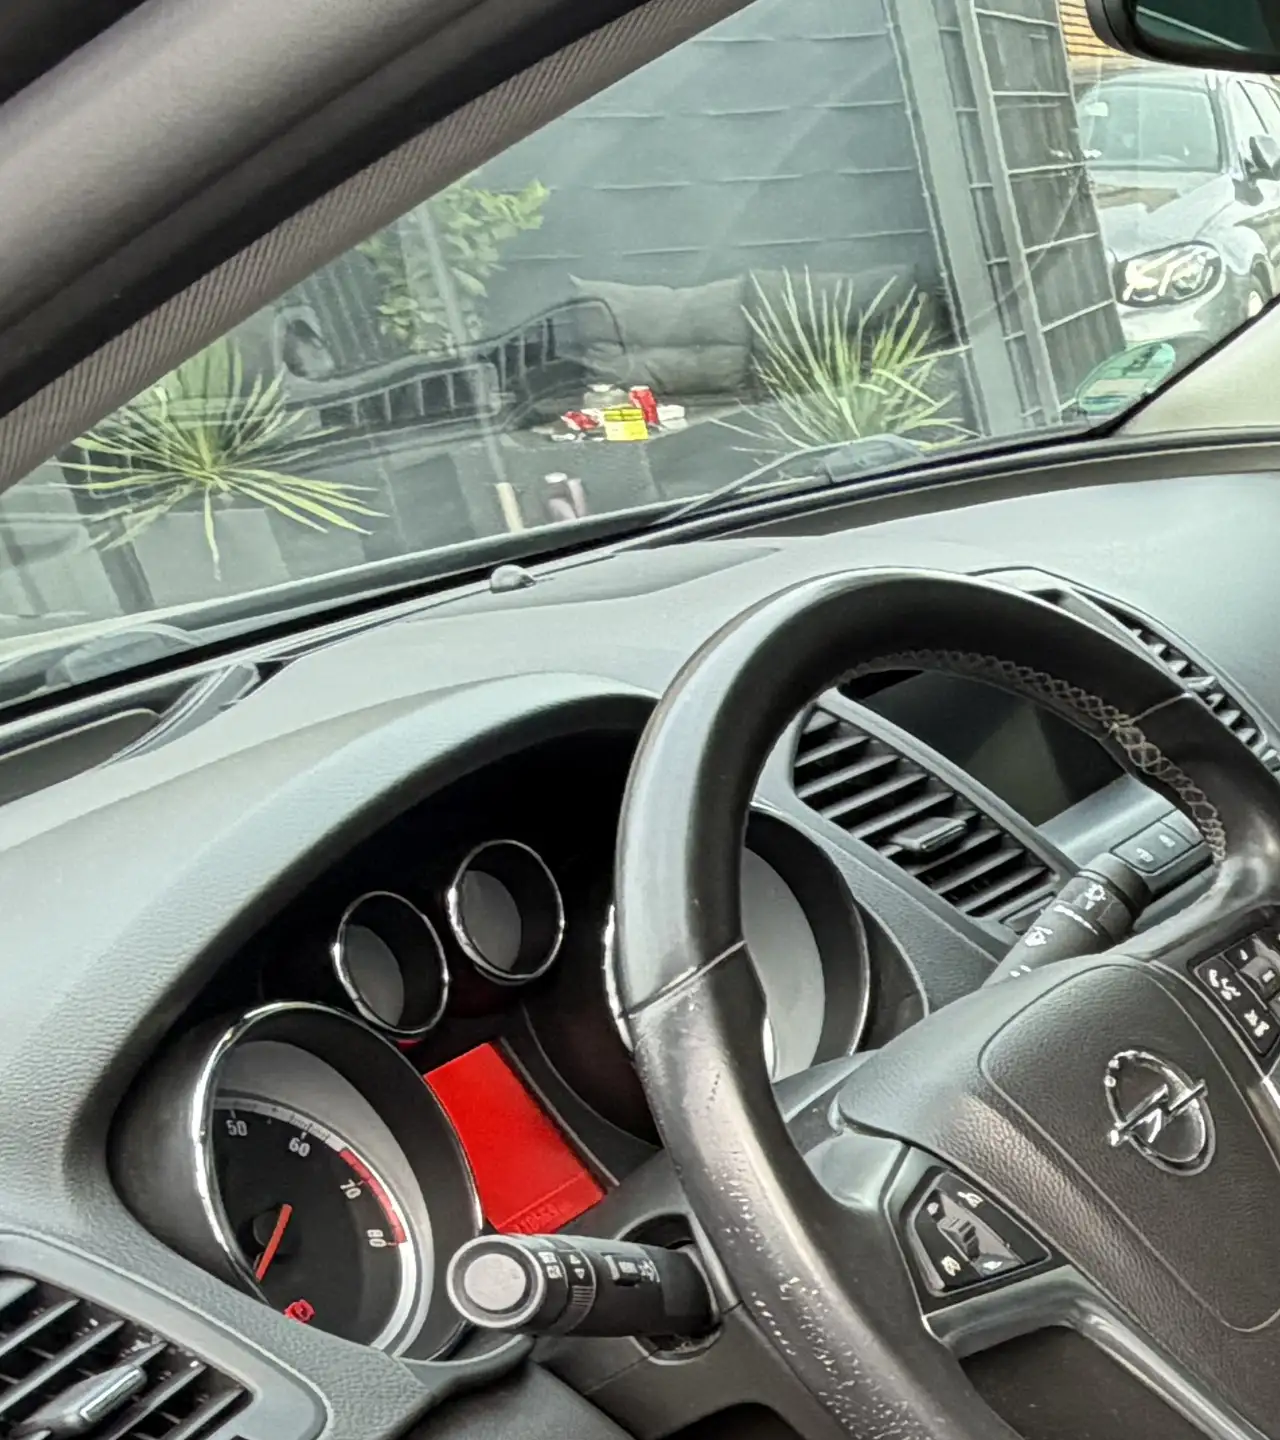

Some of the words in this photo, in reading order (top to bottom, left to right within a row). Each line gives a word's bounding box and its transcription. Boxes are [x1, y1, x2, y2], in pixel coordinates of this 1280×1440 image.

[226, 1119, 248, 1137] 50
[288, 1137, 311, 1157] 60
[340, 1178, 362, 1200] 70
[366, 1229, 387, 1248] 80
